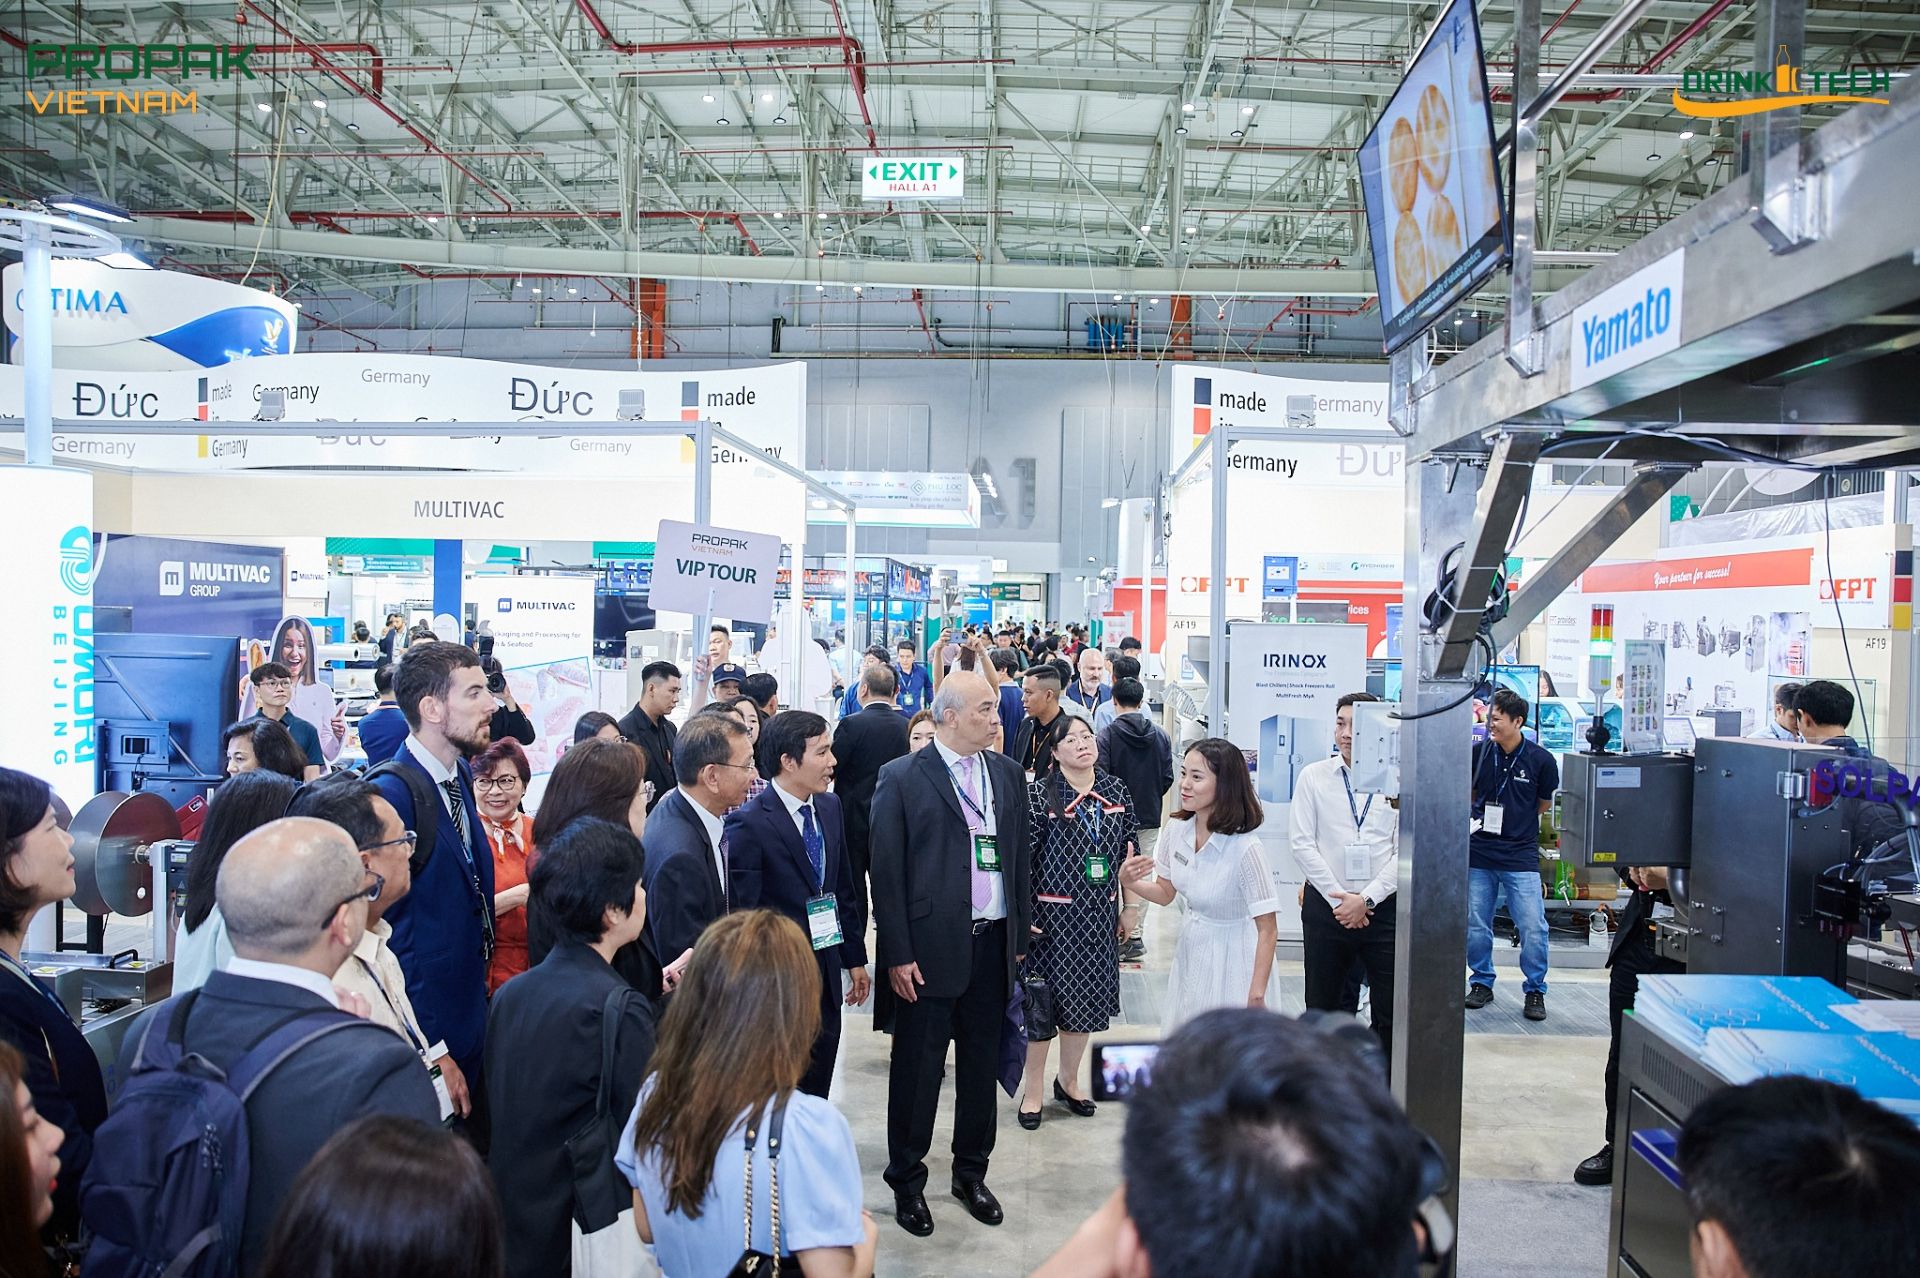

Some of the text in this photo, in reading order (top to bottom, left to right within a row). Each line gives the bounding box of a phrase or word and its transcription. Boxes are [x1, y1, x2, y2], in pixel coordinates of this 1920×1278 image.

[882, 163, 943, 181] EXIT
[889, 184, 938, 192] HALL A1
[16, 288, 129, 315] TIMA
[1582, 286, 1671, 368] Yamato
[361, 368, 431, 388] Germany
[72, 382, 159, 419] Đức
[212, 379, 232, 401] made
[508, 377, 594, 416] Đức
[707, 386, 756, 407] made
[1220, 391, 1267, 412] made
[51, 435, 136, 457] Germany
[212, 437, 248, 458] Germany
[570, 438, 632, 456] Germany
[414, 500, 504, 518] MULTIVAC
[691, 545, 733, 556] VIETNAM
[692, 533, 748, 550] PROPAK
[189, 561, 271, 583] MULTIVAC
[676, 558, 705, 576] VIP
[708, 562, 757, 584] TOUR
[190, 584, 221, 597] GROUP
[1834, 578, 1877, 599] FPT
[516, 602, 576, 611] MULTIVAC
[1173, 620, 1196, 630] AF19
[1865, 637, 1886, 650] AF19
[1263, 653, 1327, 668] IRINOX
[53, 605, 67, 765] BEIJING
